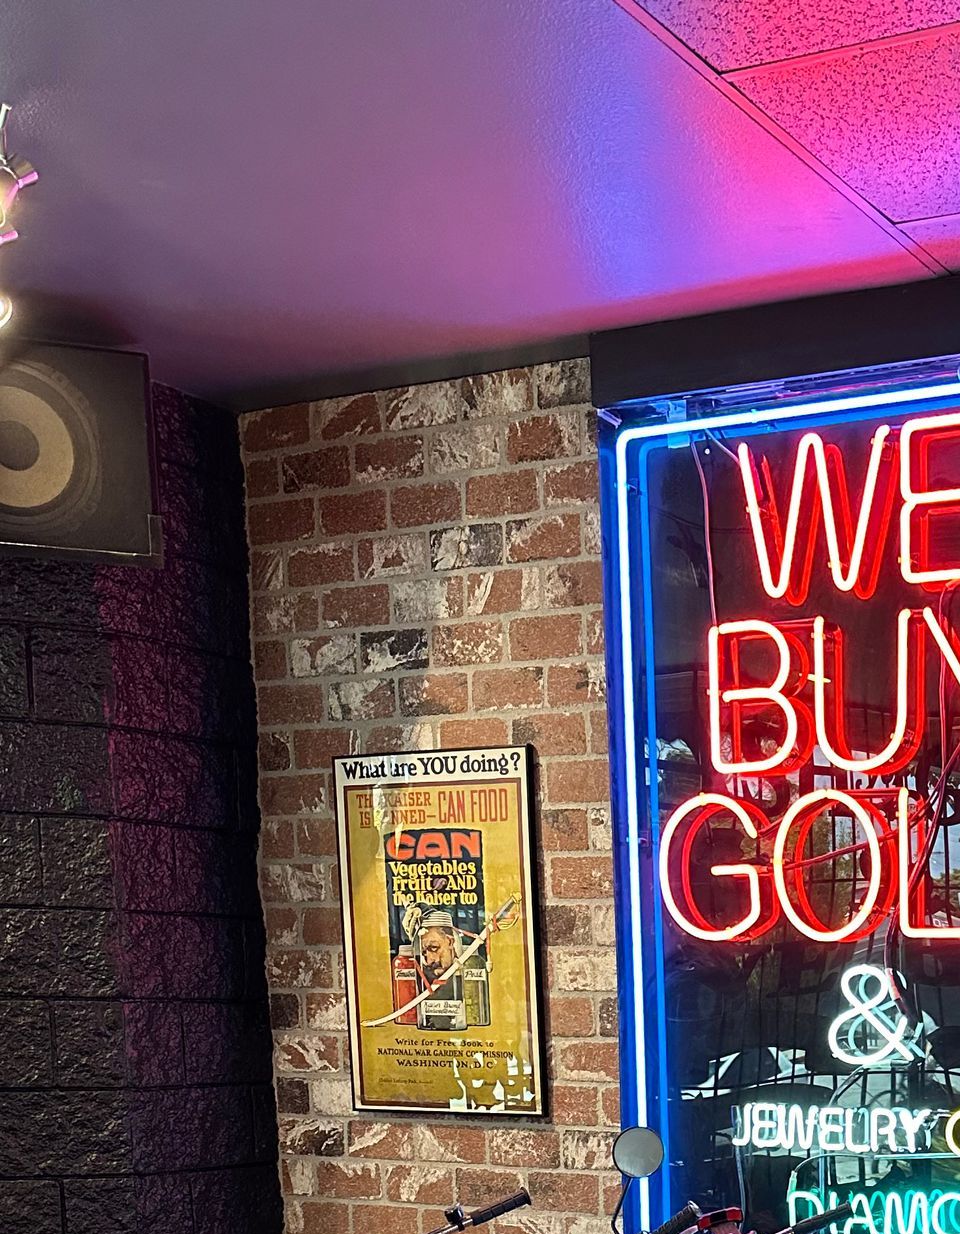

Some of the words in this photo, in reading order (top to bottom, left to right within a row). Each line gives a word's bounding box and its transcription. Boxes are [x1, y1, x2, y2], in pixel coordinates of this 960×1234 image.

[342, 760, 387, 779] What
[390, 762, 417, 777] are
[417, 756, 457, 775] YOU
[460, 752, 521, 775] doing?
[384, 791, 432, 808] KAISER
[438, 790, 466, 823] CAN
[471, 788, 508, 823] FOOD
[359, 810, 372, 828] IS
[386, 831, 480, 860] CAN
[388, 860, 476, 878] Vegetables
[392, 875, 433, 891] Fruit
[446, 875, 477, 891] AND
[392, 890, 414, 906] the
[415, 890, 458, 906] Kaiser
[460, 890, 478, 906] too
[828, 963, 916, 1065] &
[395, 1038, 419, 1046] Write
[421, 1038, 434, 1046] for
[436, 1039, 456, 1047] Free
[377, 1048, 413, 1056] NATIONAL
[414, 1049, 432, 1057] WAR
[433, 1049, 463, 1057] GARDEN
[732, 1104, 931, 1153] JEWELRY
